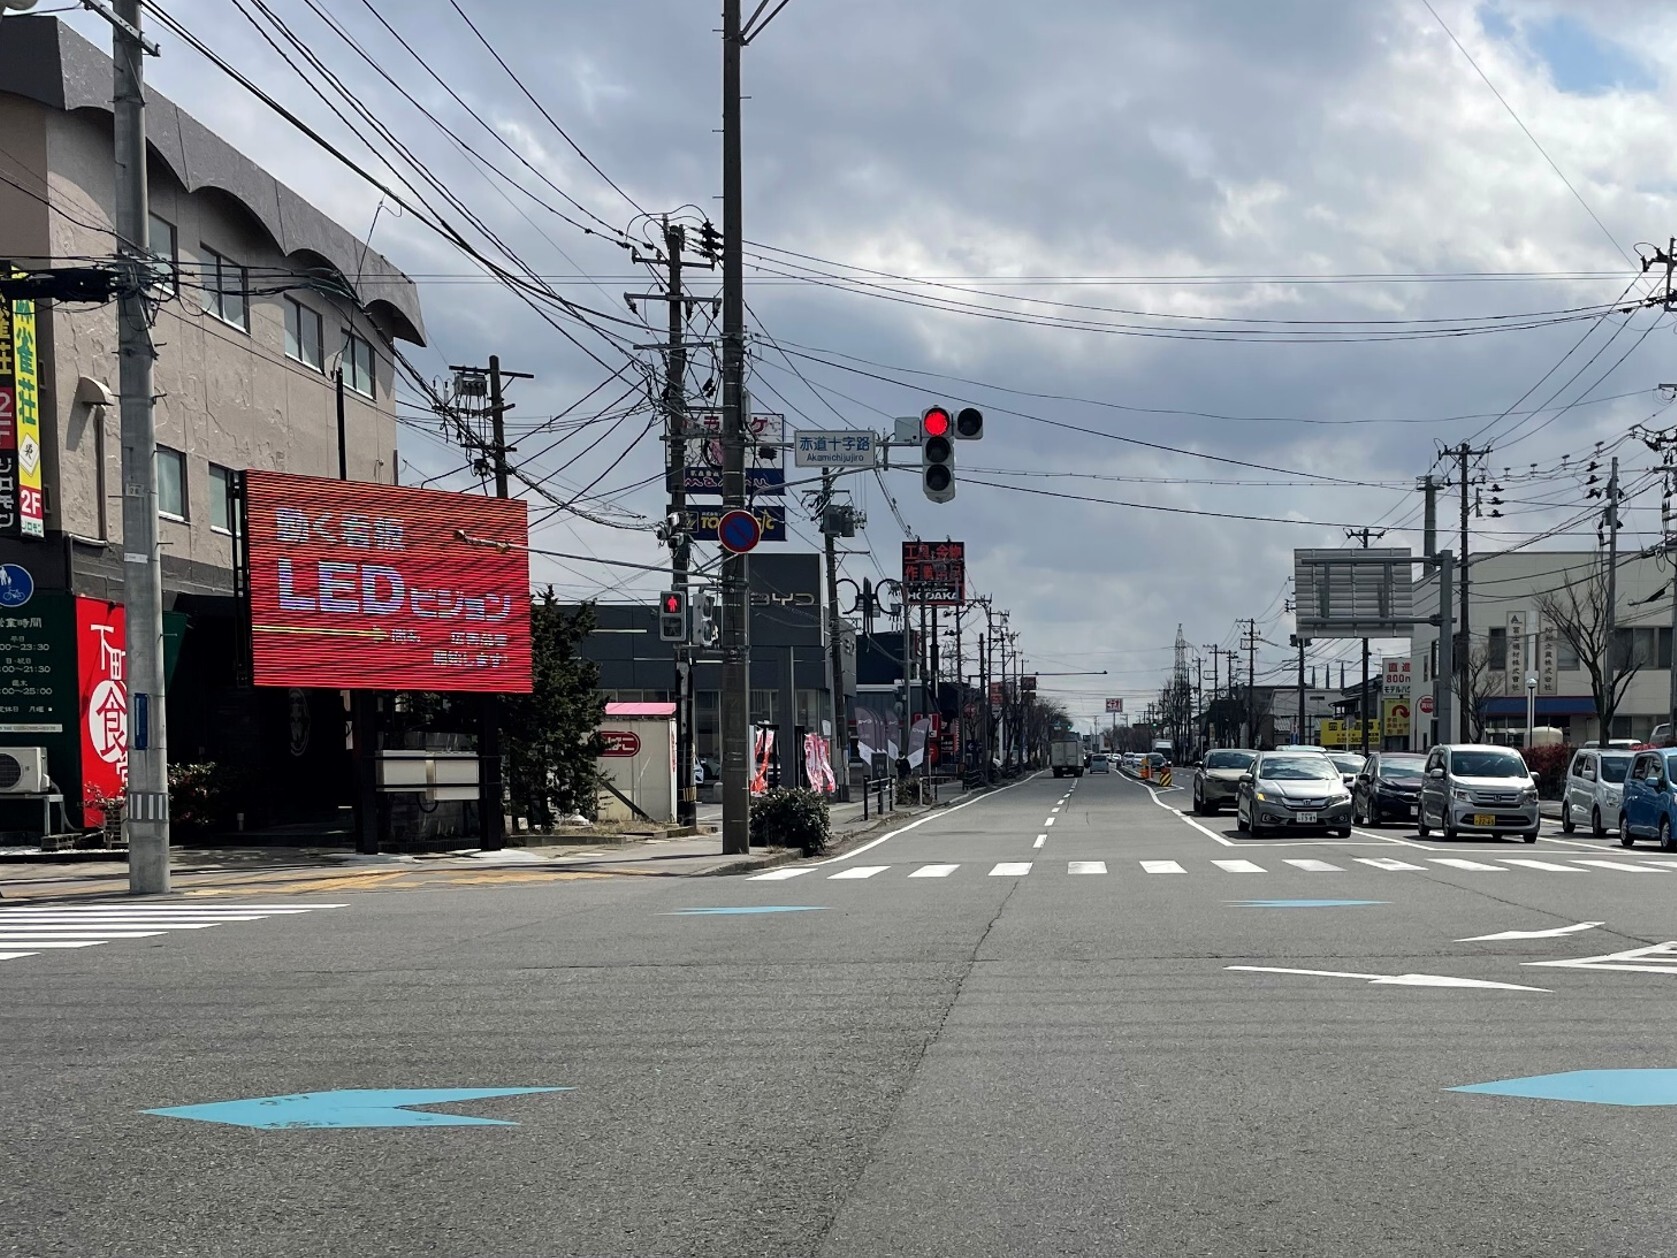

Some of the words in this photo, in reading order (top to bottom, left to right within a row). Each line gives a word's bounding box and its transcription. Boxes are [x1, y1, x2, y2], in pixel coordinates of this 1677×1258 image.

[800, 436, 870, 451] 赤道十字路
[21, 489, 41, 515] 2F
[750, 592, 815, 606] BYD
[604, 737, 635, 751] ばこ
